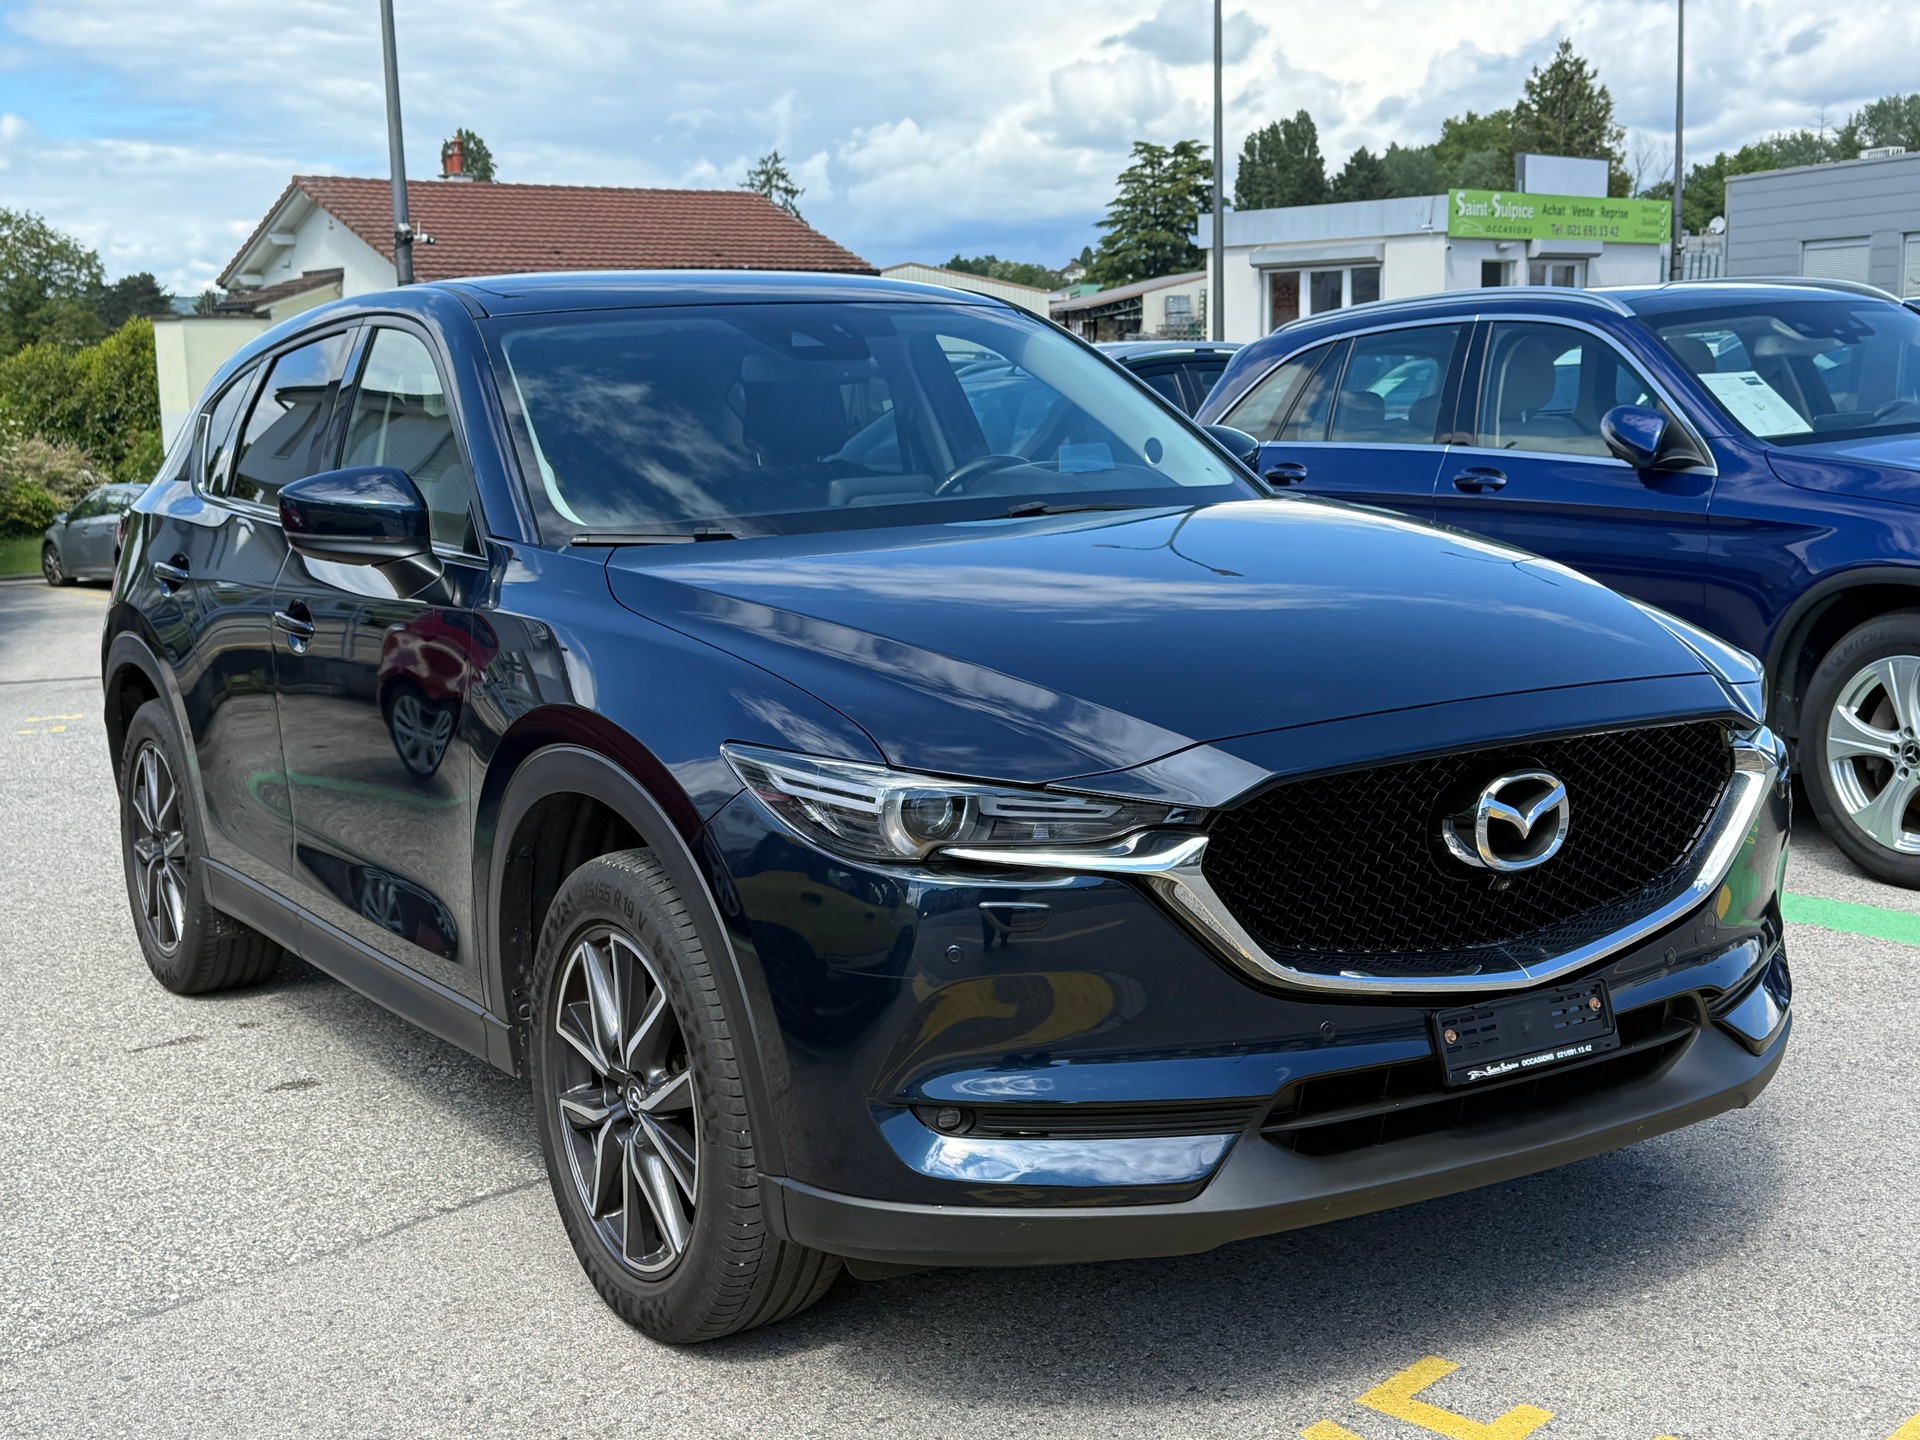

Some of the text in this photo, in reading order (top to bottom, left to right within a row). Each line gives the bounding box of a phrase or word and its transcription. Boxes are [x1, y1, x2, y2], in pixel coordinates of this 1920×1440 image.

[1542, 203, 1566, 216] Achat
[1571, 205, 1594, 218] Vente
[1600, 206, 1628, 220] Reprise
[1486, 224, 1533, 235] OCCASIONS
[1567, 224, 1581, 237] 021
[1583, 225, 1597, 237] 691
[1600, 226, 1608, 237] 13
[1610, 227, 1620, 238] 42
[623, 896, 635, 919] 19
[1521, 1054, 1554, 1066] OCCASIONS
